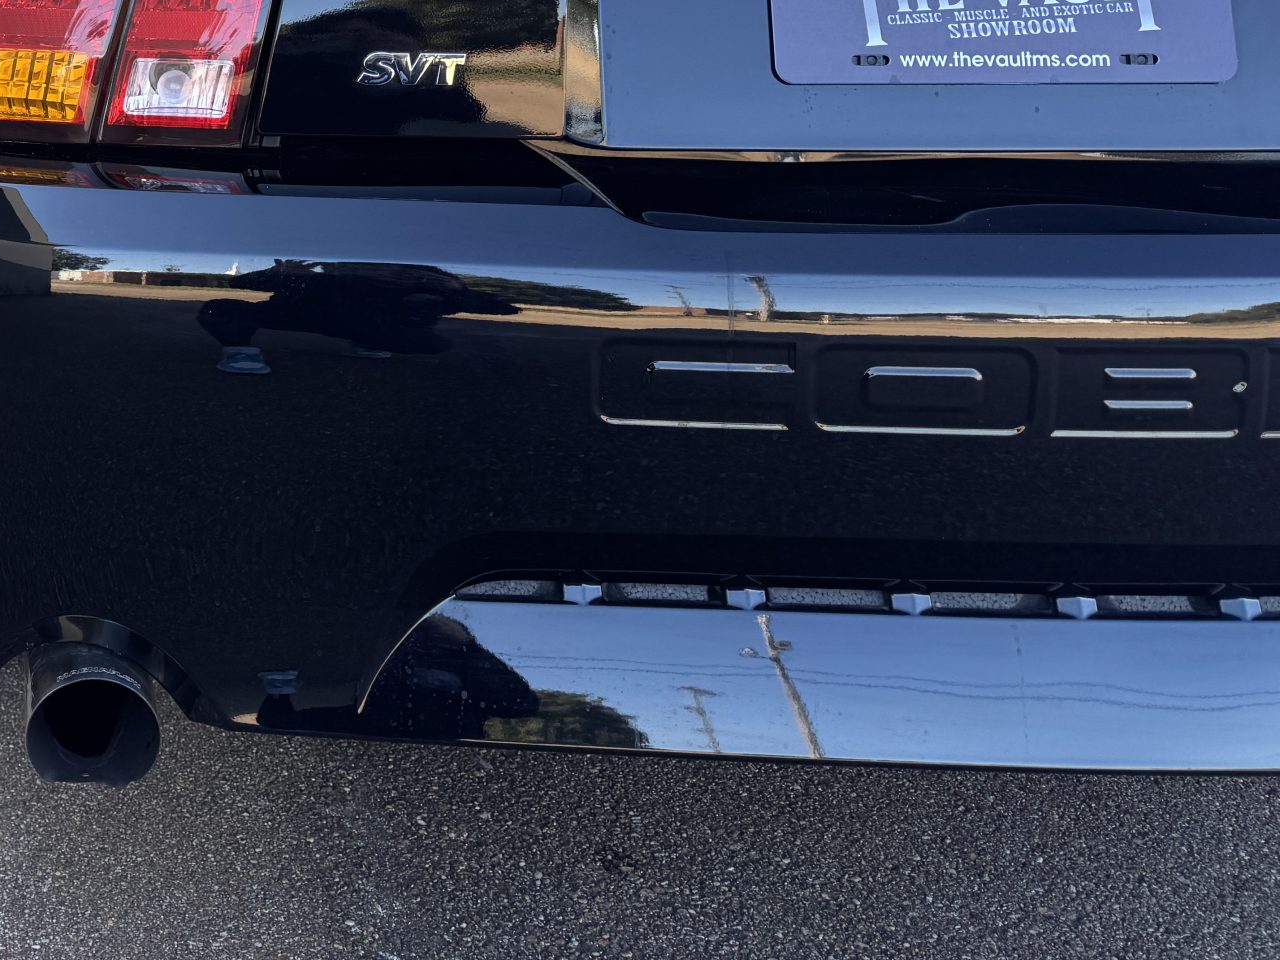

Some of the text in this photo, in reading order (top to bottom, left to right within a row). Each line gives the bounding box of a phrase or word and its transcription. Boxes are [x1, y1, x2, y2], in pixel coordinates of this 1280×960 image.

[887, 1, 1134, 25] CLASSIC MUSCLE AND EXOTIC CAR
[947, 17, 1078, 39] SHOWROOM
[356, 51, 467, 86] SVT
[899, 51, 1111, 68] www.thevaultms.com
[594, 339, 1280, 438] COB
